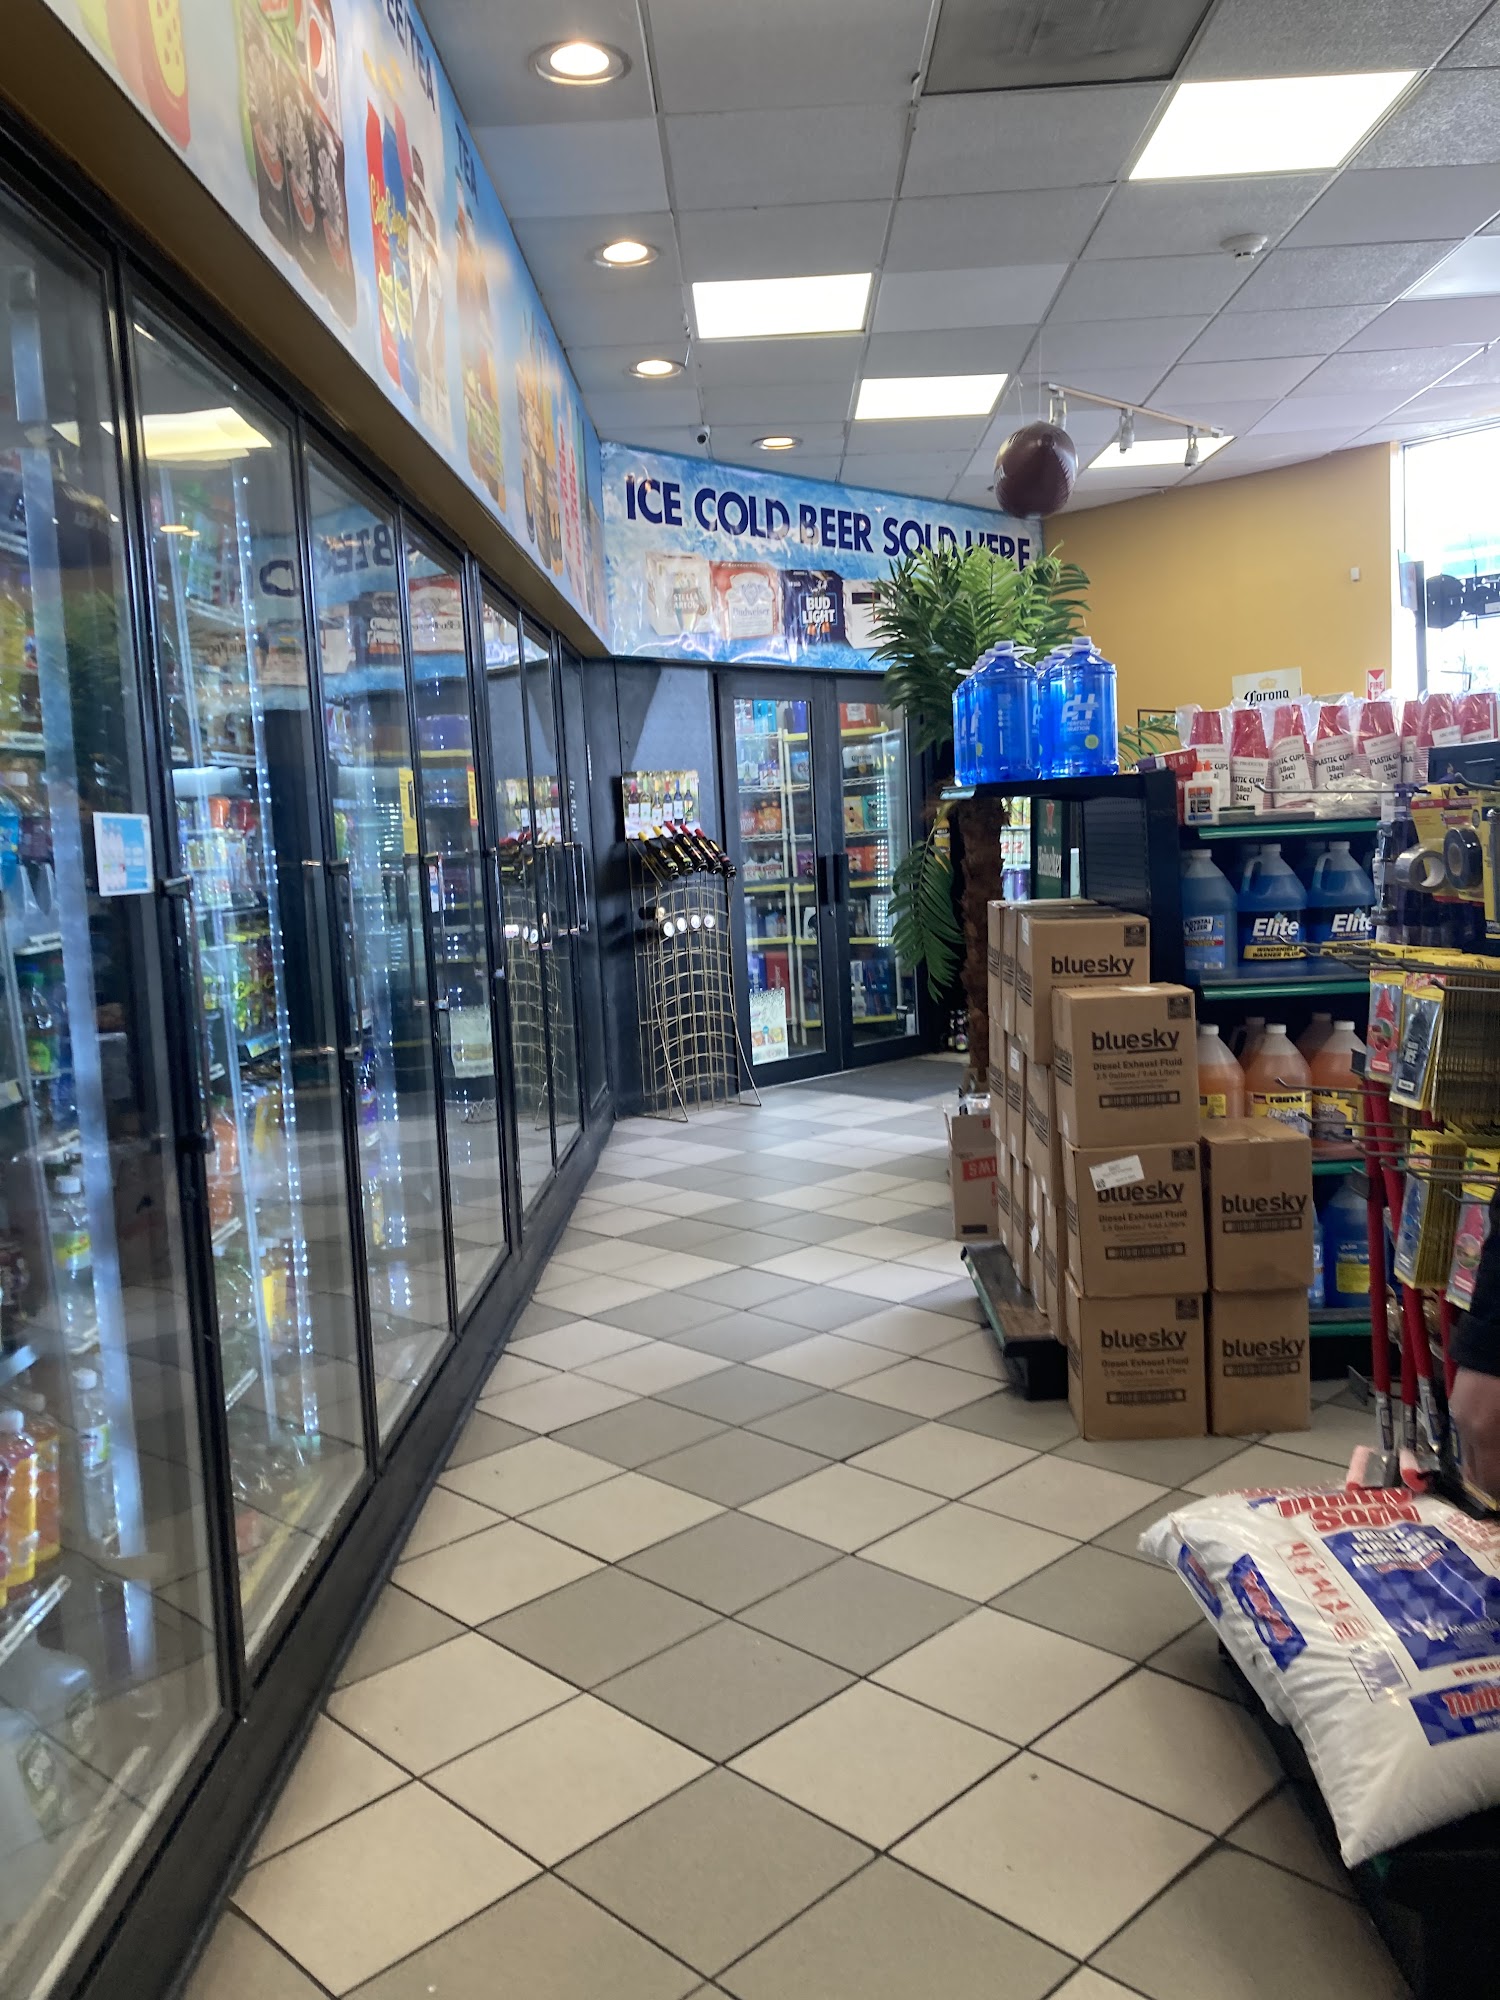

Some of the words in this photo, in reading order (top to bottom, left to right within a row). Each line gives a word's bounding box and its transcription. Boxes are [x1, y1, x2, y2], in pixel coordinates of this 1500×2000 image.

[455, 120, 479, 206] TEA
[626, 474, 683, 526] ICE
[694, 488, 790, 540] COLD
[799, 503, 874, 553] BEER
[883, 517, 957, 560] SOLD
[807, 597, 831, 610] BUD
[733, 606, 770, 616] Budweiser
[802, 609, 836, 623] LIGHT
[1369, 681, 1383, 690] FIRE
[1244, 688, 1290, 706] Corona
[1289, 753, 1305, 762] CUPS
[1314, 756, 1337, 767] PLASTIC
[1370, 755, 1392, 766] PLASTIC
[1278, 763, 1296, 774] (18oz)
[1327, 763, 1345, 773] (18oz)
[1281, 772, 1296, 781] 24CT
[1329, 772, 1344, 781] 24CT
[1235, 785, 1253, 793] (18oz)
[1235, 793, 1250, 801] 24CT
[1252, 916, 1300, 937] Elite
[1331, 913, 1373, 933] Elite
[1051, 954, 1135, 977] bluesky
[1091, 1027, 1180, 1052] bluesky
[1093, 1061, 1121, 1070] Diesel
[1122, 1059, 1158, 1069] Exhaust
[1160, 1057, 1183, 1067] Fluid
[1097, 1179, 1185, 1205] bluesky
[1222, 1191, 1309, 1215] bluesky
[1099, 1213, 1126, 1222] Diesel
[1128, 1211, 1163, 1221] Exhaust
[1164, 1209, 1188, 1218] Fluid
[1100, 1327, 1187, 1351] bluesky
[1222, 1336, 1306, 1360] bluesky
[1101, 1359, 1128, 1368] Diesel
[1131, 1358, 1165, 1367] Exhaust
